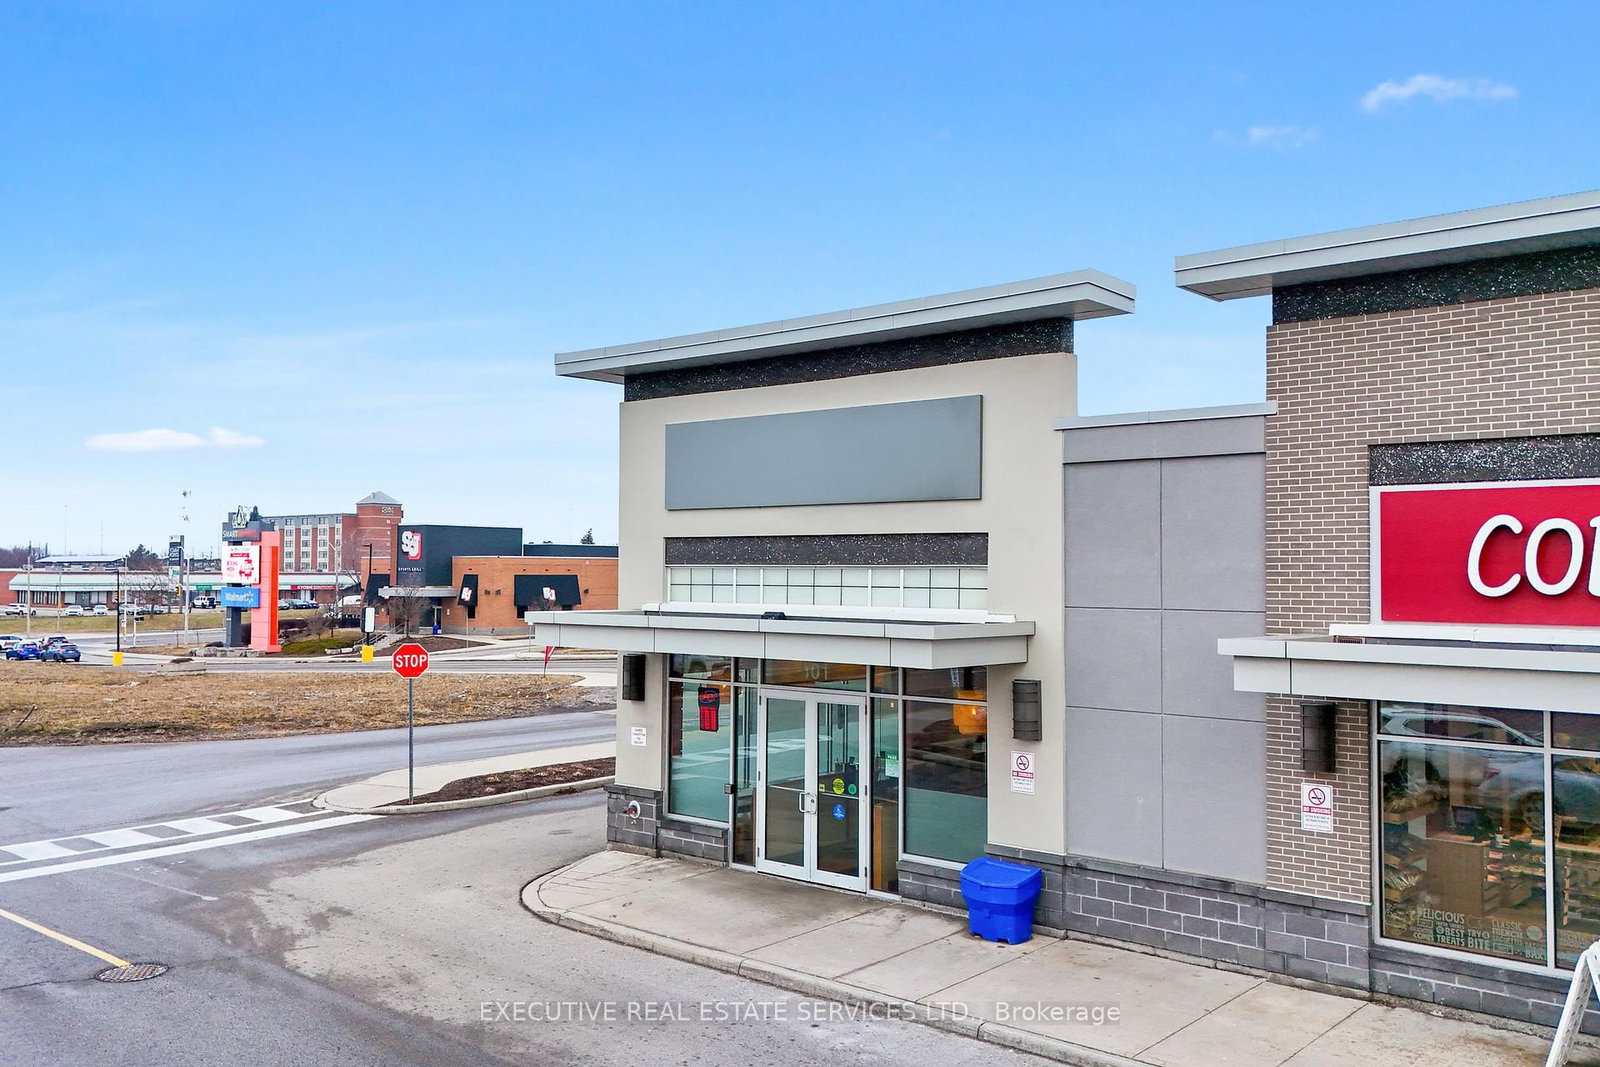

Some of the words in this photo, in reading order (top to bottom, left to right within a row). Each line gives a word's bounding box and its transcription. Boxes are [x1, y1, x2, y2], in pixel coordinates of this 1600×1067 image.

[395, 654, 427, 668] STOP
[803, 662, 828, 681] 101
[1417, 906, 1465, 925] DELICIOUS
[1444, 927, 1465, 939] BEST
[1467, 928, 1480, 938] TRY
[1436, 934, 1465, 947] TREATS
[1467, 937, 1491, 951] BITE
